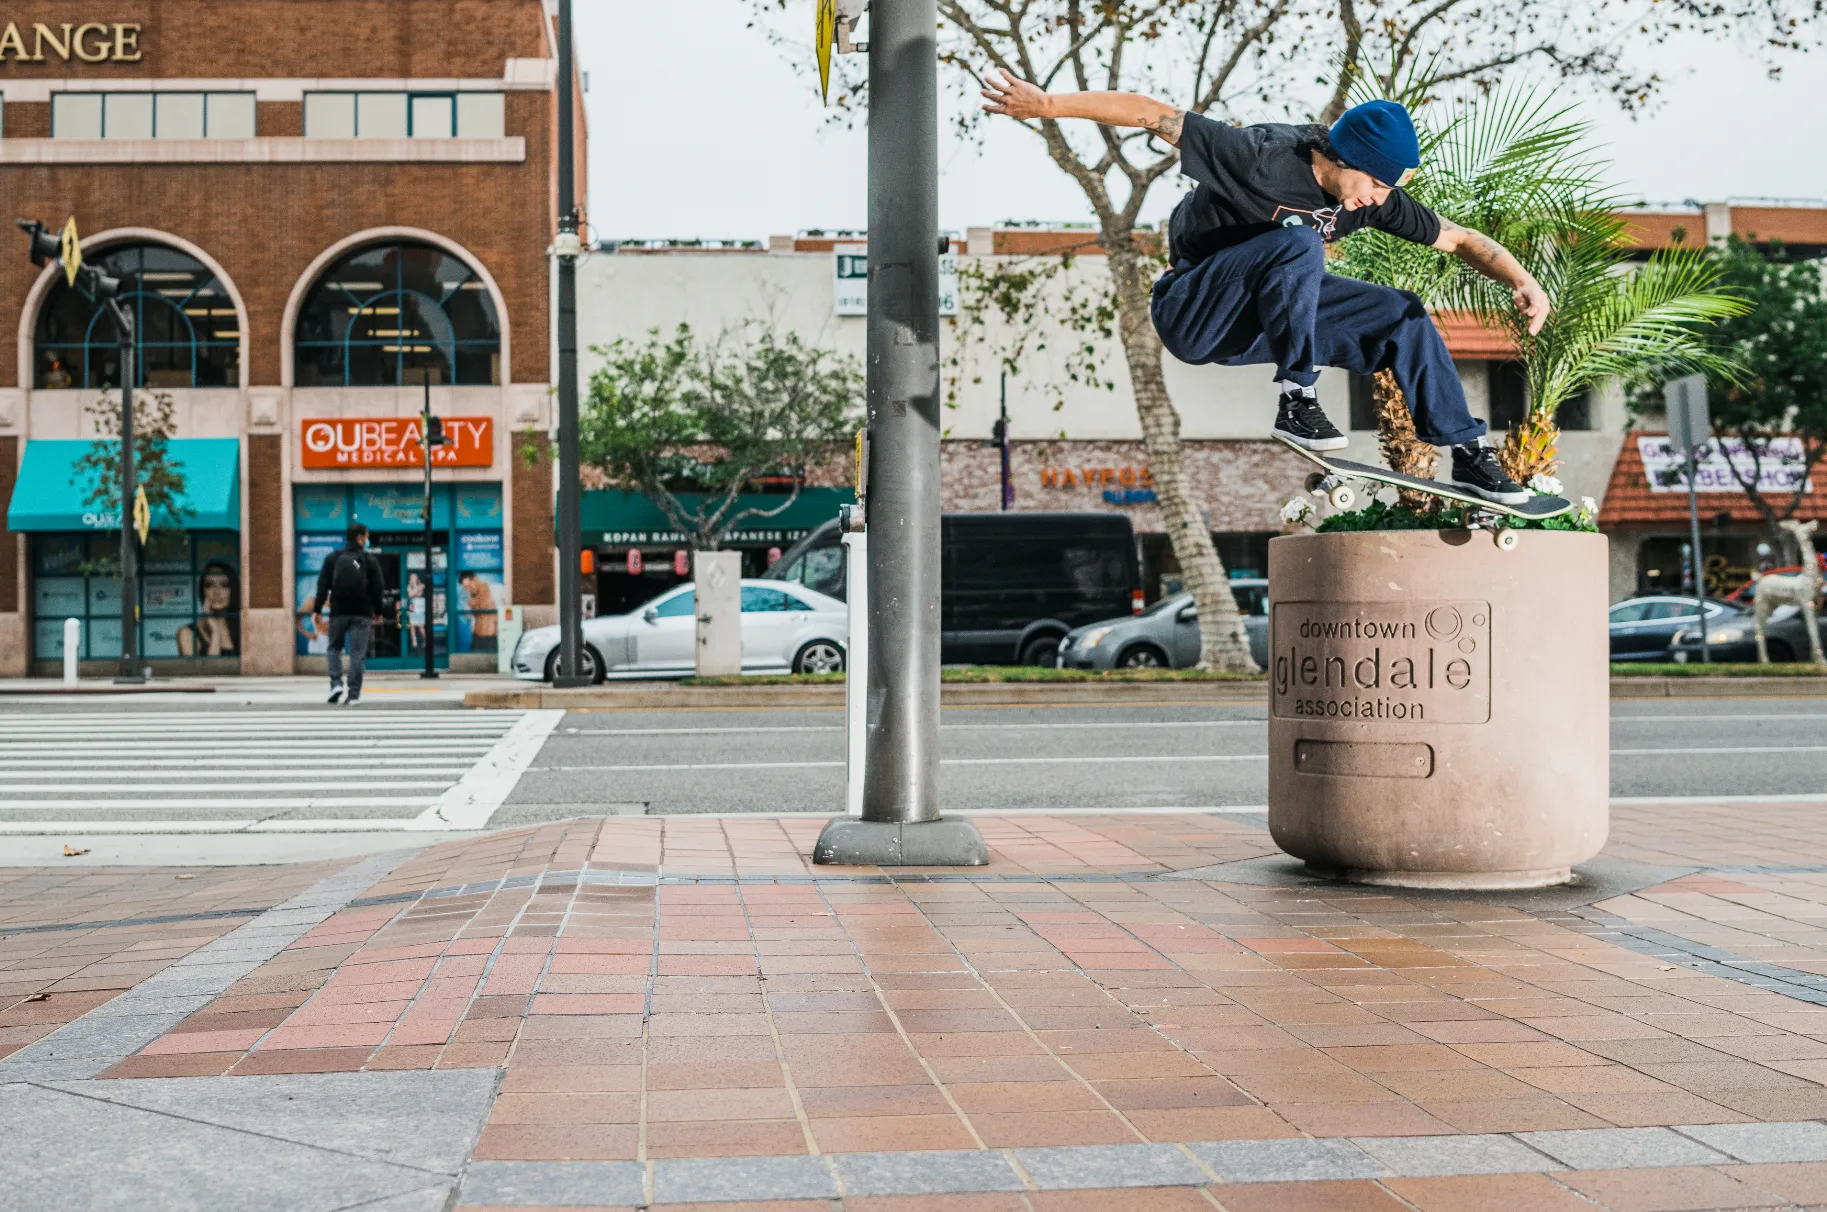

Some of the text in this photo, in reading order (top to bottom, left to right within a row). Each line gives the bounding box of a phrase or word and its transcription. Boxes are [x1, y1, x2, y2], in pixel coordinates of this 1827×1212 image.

[0, 21, 142, 62] ANGE
[337, 451, 417, 463] MEDICAL
[603, 531, 647, 543] KOPAN
[652, 531, 697, 542] RAME
[722, 530, 781, 541] APANESE
[1301, 618, 1415, 639] downtown
[1277, 647, 1471, 696] glendale
[1296, 697, 1424, 719] association
